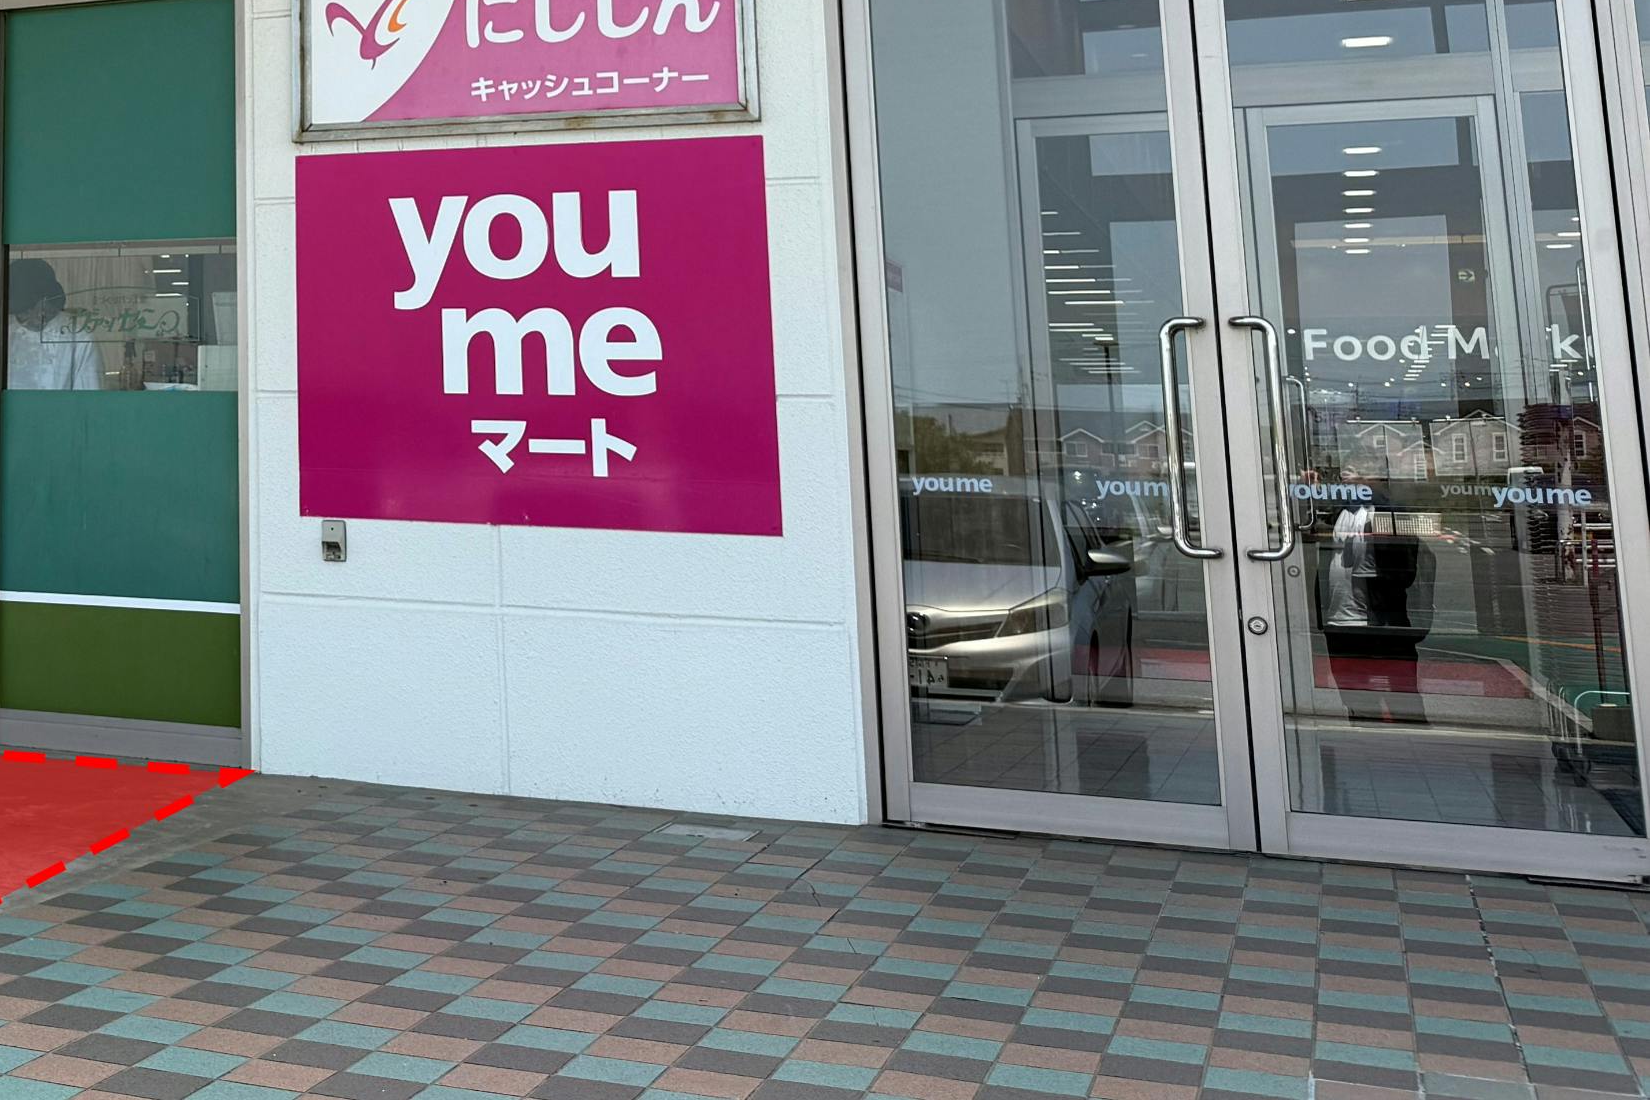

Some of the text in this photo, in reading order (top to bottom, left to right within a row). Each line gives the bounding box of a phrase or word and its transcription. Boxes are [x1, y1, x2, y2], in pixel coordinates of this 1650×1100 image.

[470, 67, 711, 103] キャッシュコーナー
[388, 190, 642, 311] you
[441, 305, 663, 397] me
[1303, 325, 1429, 361] Food
[471, 418, 637, 478] マート
[1096, 479, 1169, 500] youm
